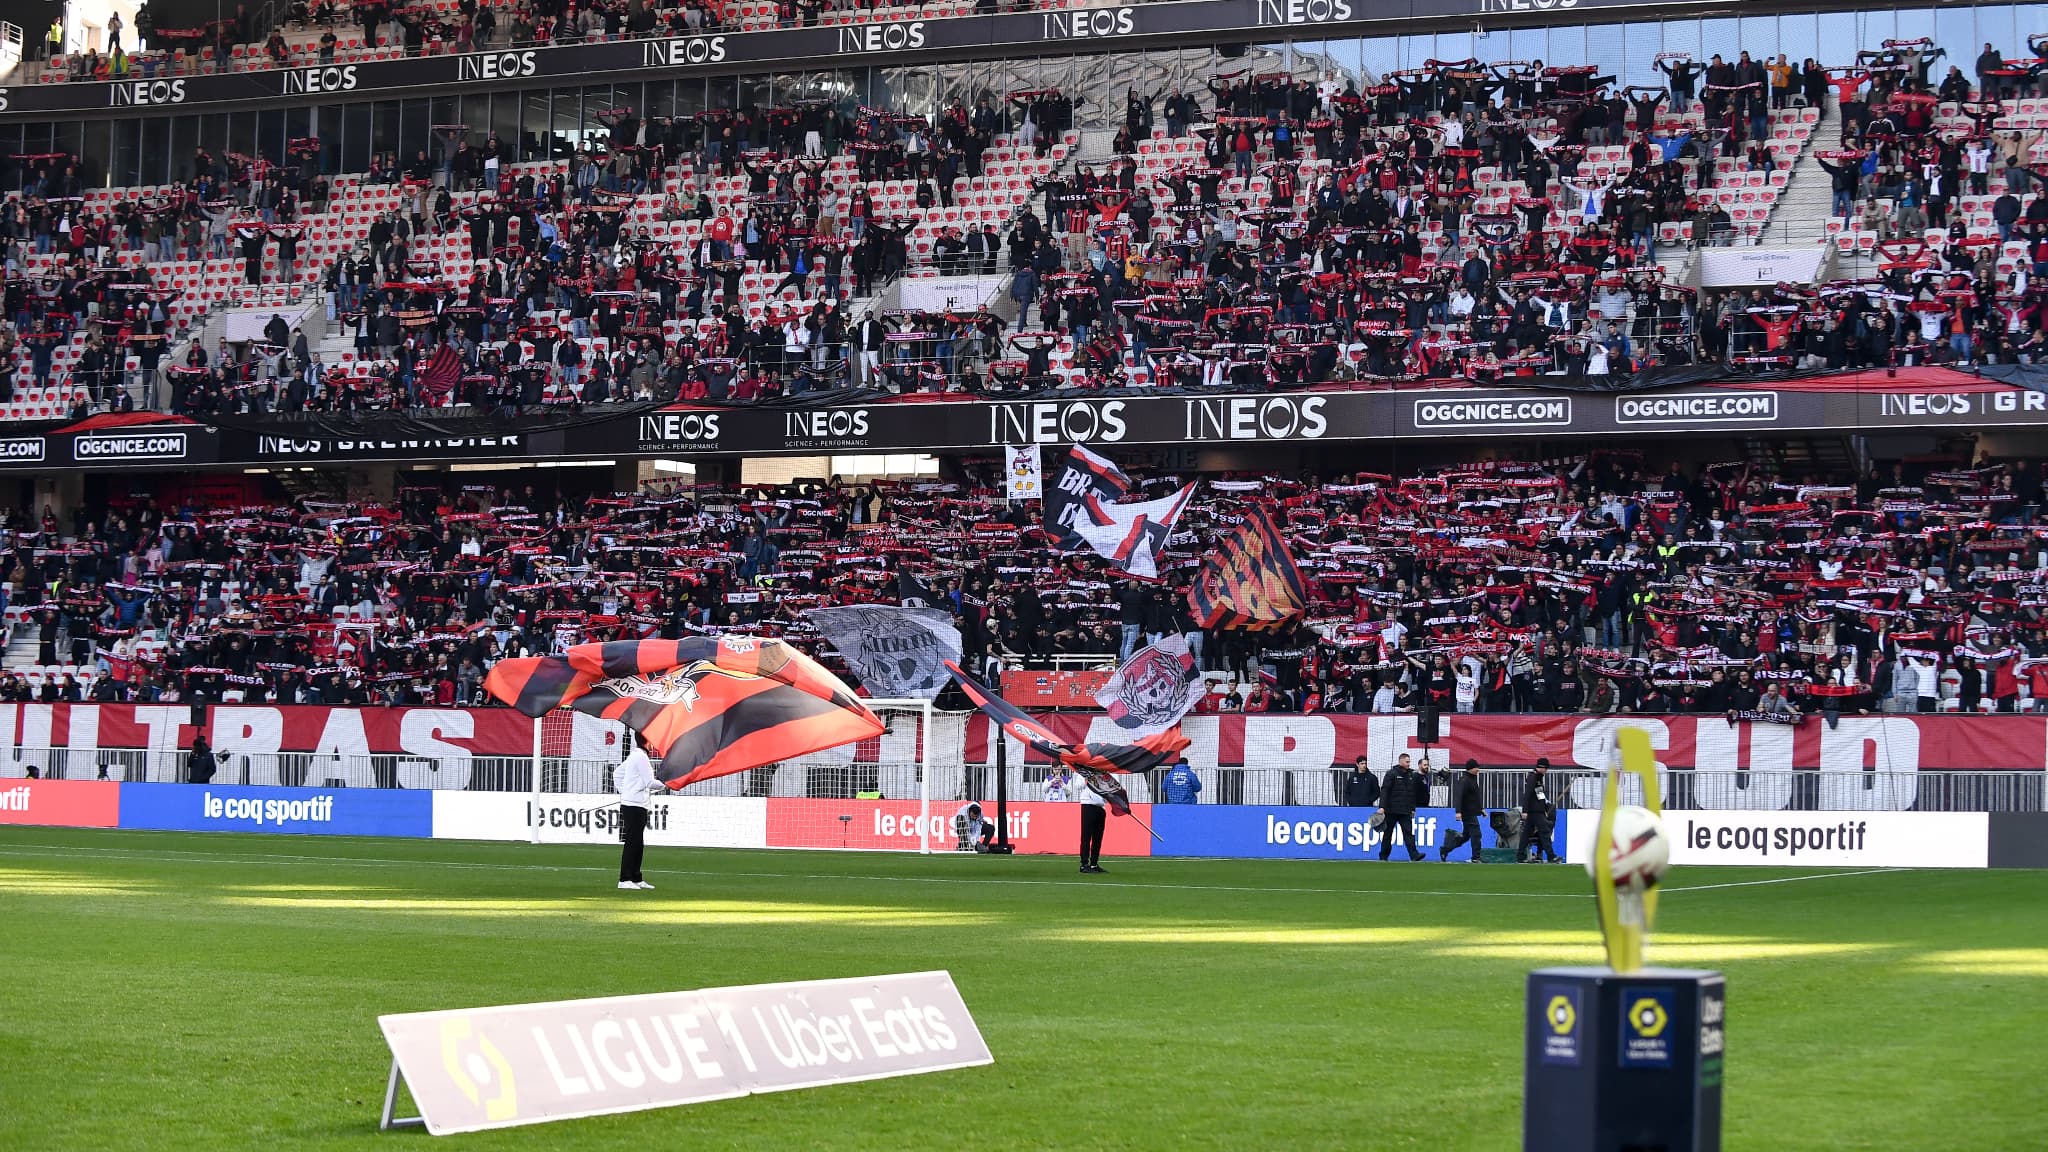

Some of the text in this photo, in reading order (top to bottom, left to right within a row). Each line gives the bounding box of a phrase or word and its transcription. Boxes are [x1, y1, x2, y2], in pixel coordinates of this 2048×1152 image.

[1043, 8, 1133, 39] INEOS
[1257, 0, 1351, 25] INEOS
[838, 22, 925, 53] INEOS
[642, 36, 726, 67] INEOS
[457, 51, 536, 81] INEOS
[109, 79, 185, 106] INEOS
[282, 65, 357, 95] INEOS
[1421, 403, 1563, 421] OGCNICE.COM
[1623, 398, 1769, 417] OGCNICE.COM
[1881, 393, 1970, 415] INEOS
[638, 414, 720, 440] INEOS
[784, 410, 869, 436] INEOS
[988, 401, 1126, 444] INEOS
[1184, 397, 1327, 440] INEOS
[79, 438, 181, 454] OGCNICE.COM
[259, 435, 321, 453] INEOS
[802, 508, 833, 517] OGC NICE
[1447, 525, 1492, 534] NISSA
[864, 573, 885, 581] NICE
[225, 674, 265, 685] NISSA
[308, 667, 336, 675] OGC
[1754, 670, 1803, 680] NISSA
[0, 704, 474, 790] ULTRAS
[1571, 717, 1921, 813] SUD
[204, 792, 333, 826] le coq sportif
[550, 809, 591, 834] coq
[594, 804, 669, 835] sptif
[874, 808, 896, 836] le
[1266, 814, 1291, 844] le
[1294, 821, 1344, 851] coq
[1687, 819, 1866, 856] le coq sportif
[531, 996, 957, 1096] LIGUE 1 Uber Eats
